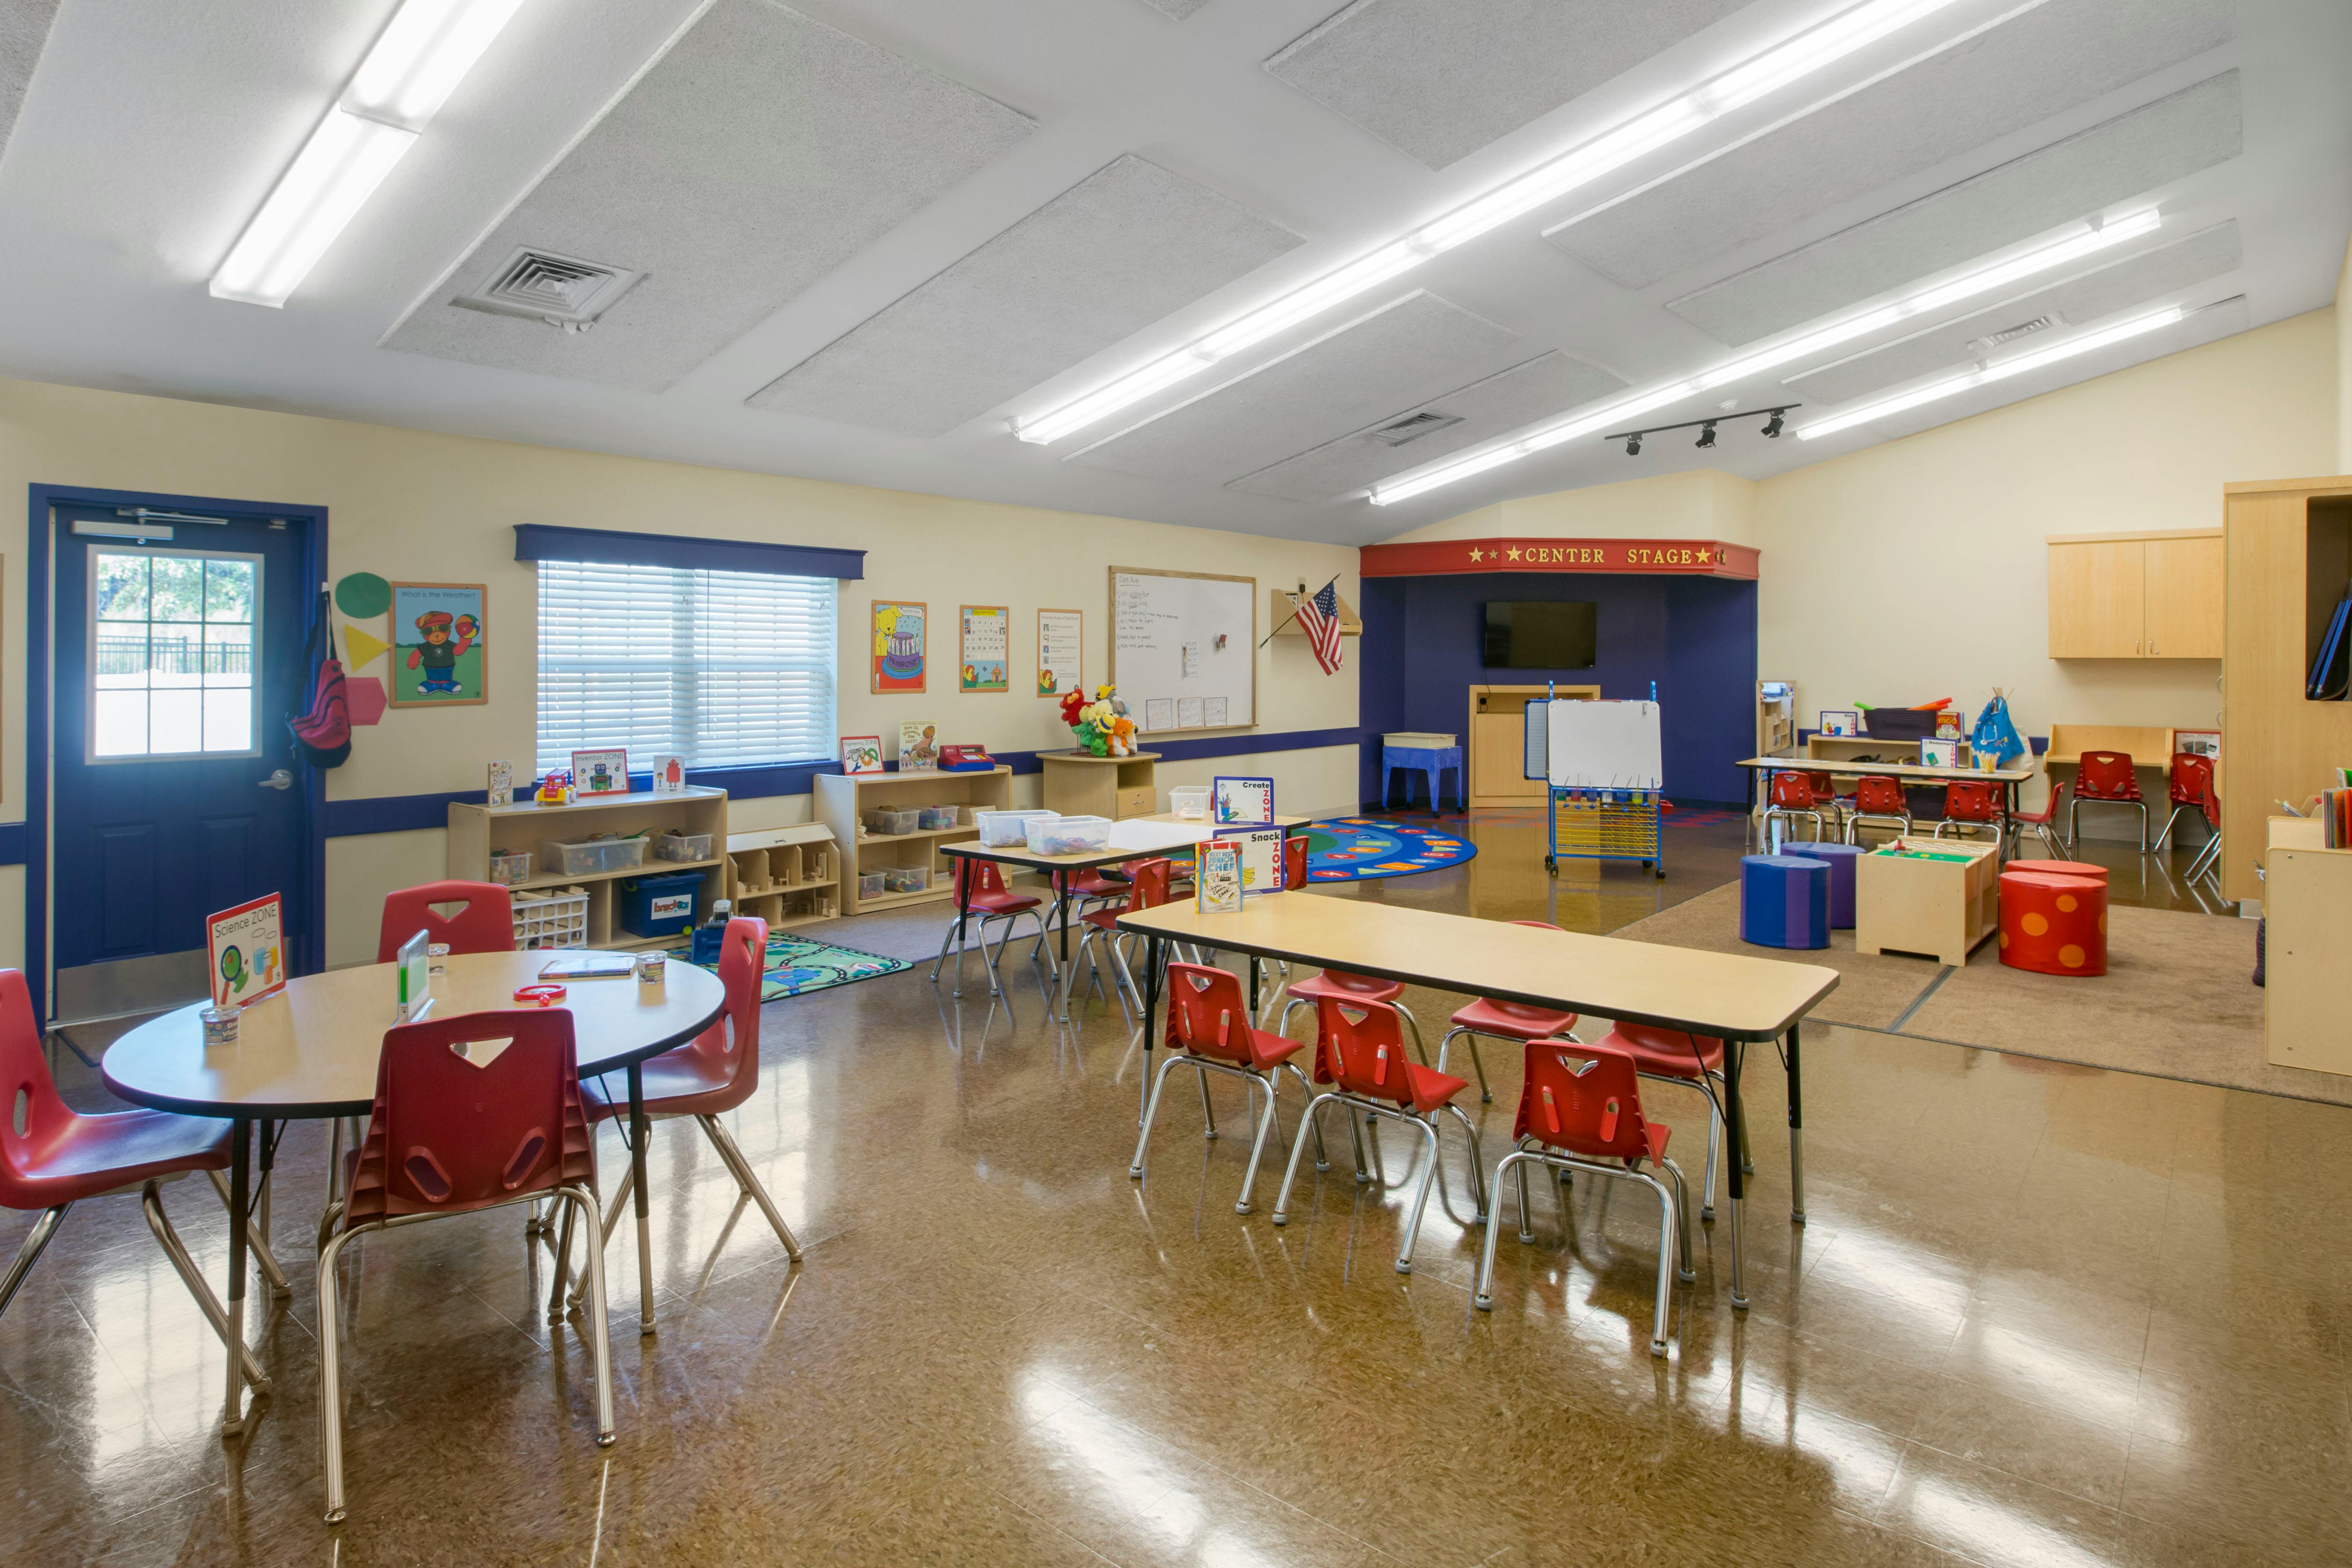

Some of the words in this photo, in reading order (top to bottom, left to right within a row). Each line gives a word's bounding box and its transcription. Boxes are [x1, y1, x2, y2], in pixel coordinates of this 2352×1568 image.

[1525, 548, 1604, 563] CENTER
[1627, 548, 1692, 564] STAGE
[889, 656, 918, 668] PRIMROSE
[1251, 832, 1280, 842] Snack
[1207, 863, 1234, 872] CHEF
[1272, 842, 1280, 887] ZONE
[1218, 888, 1230, 898] COOK!
[654, 900, 689, 912] brackitz
[215, 918, 249, 938] Science
[252, 904, 277, 925] ZONE
